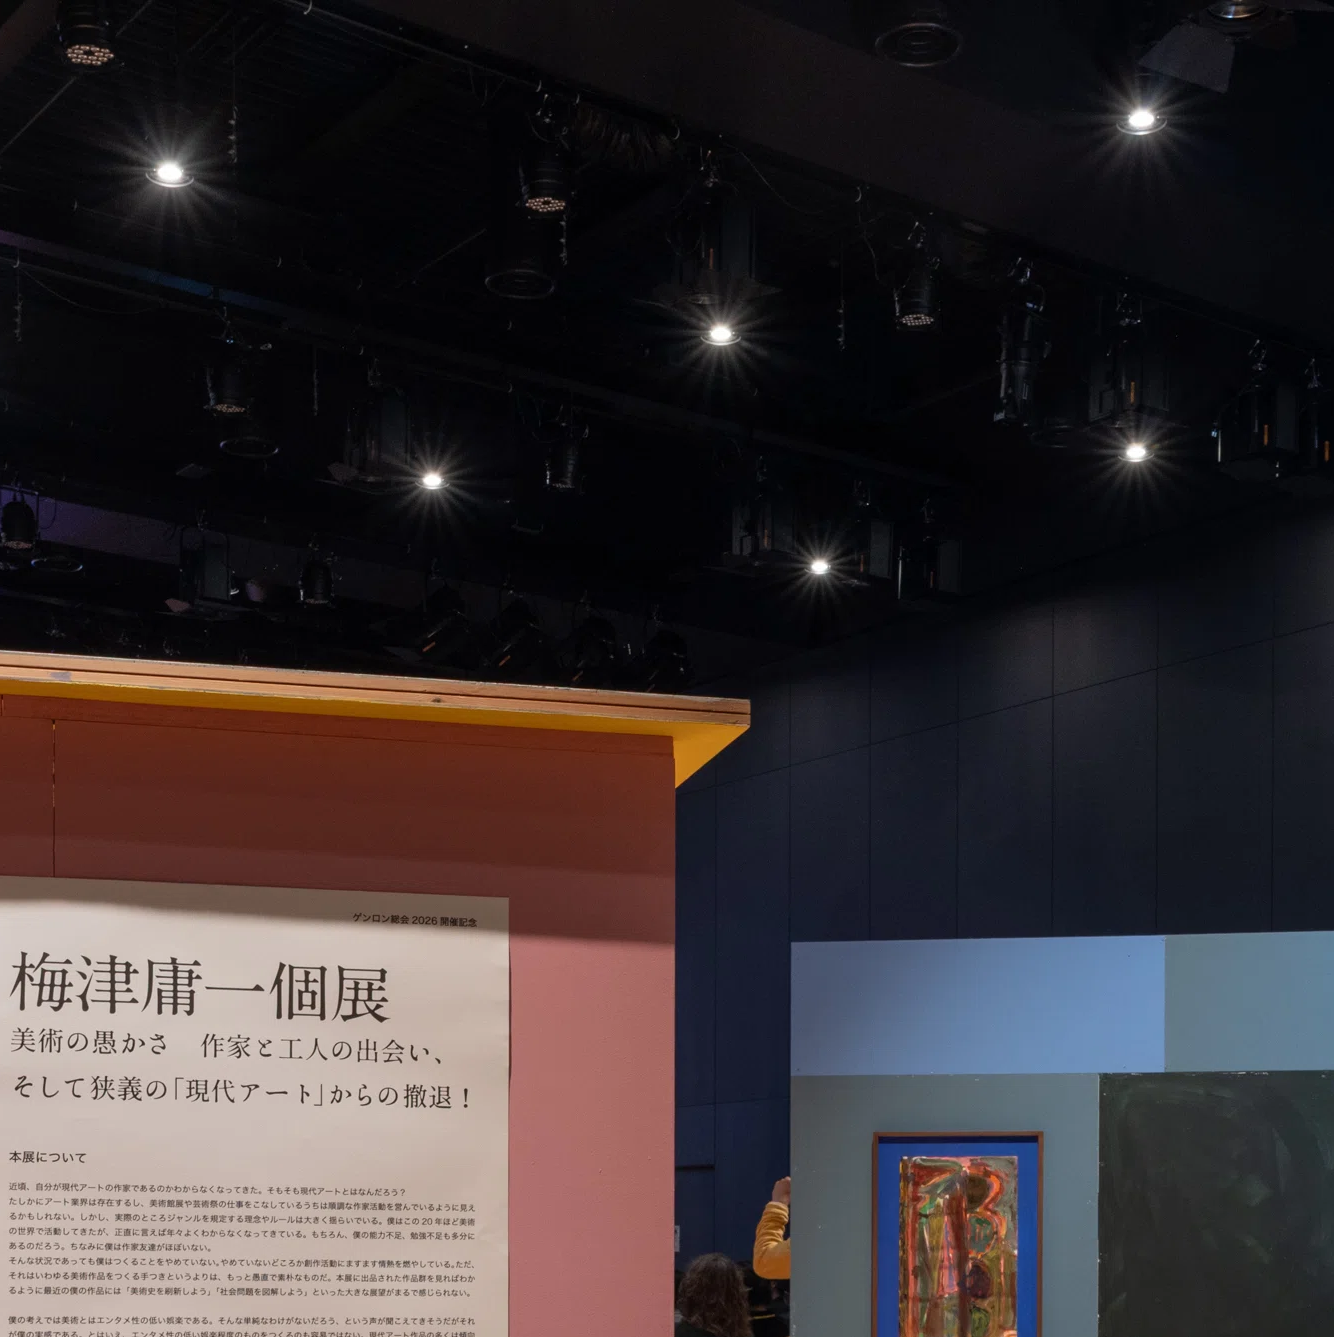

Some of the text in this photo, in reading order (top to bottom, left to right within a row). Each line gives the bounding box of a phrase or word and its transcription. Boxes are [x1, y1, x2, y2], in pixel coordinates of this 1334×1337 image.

[352, 912, 478, 928] ゲンロン総会 2026 開催記念
[9, 951, 391, 1024] 梅津庸一個展
[10, 1028, 444, 1066] 美術の愚かさ 作家と工人の出会い、
[13, 1075, 471, 1110] そして狭義の「現代アート」からの撤退！
[9, 1151, 87, 1164] 本展について
